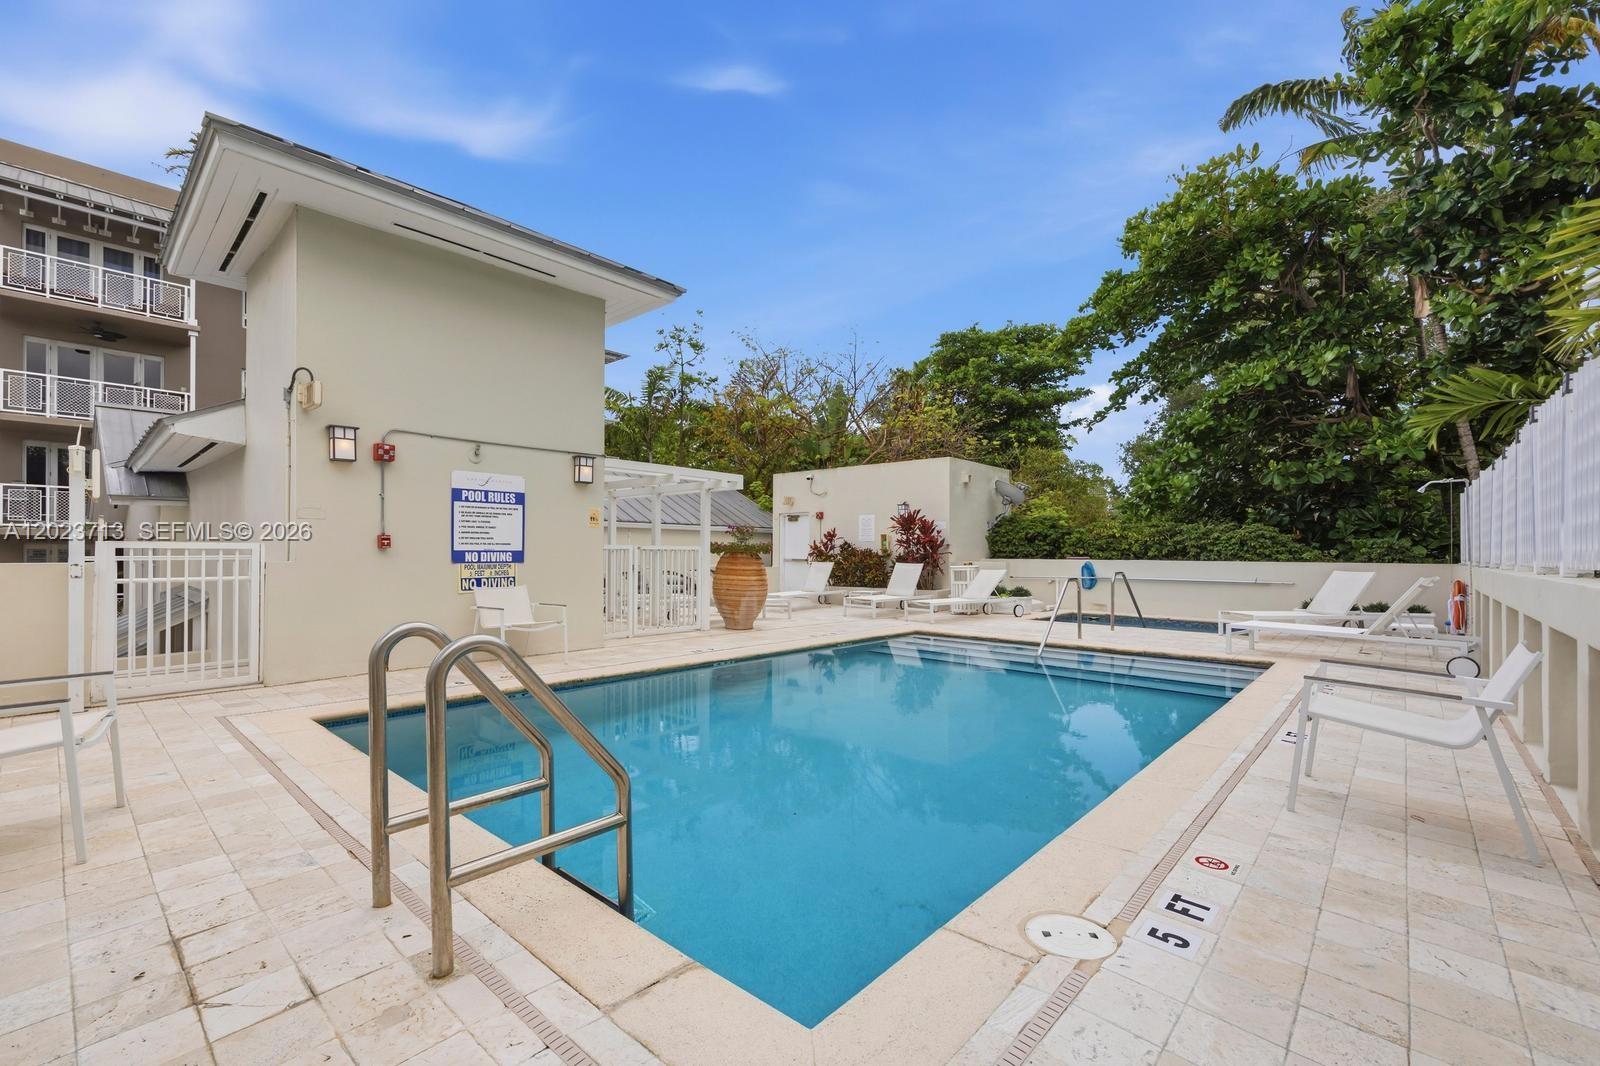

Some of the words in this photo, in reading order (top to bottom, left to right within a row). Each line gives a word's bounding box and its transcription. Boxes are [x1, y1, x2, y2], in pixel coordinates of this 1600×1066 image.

[462, 490, 487, 503] POOL
[488, 492, 516, 504] RULES
[465, 552, 478, 562] NO
[480, 552, 513, 562] DIVING
[462, 579, 476, 590] NO
[481, 577, 514, 588] DIVING
[1165, 893, 1211, 922] FT
[1147, 927, 1190, 949] 5
